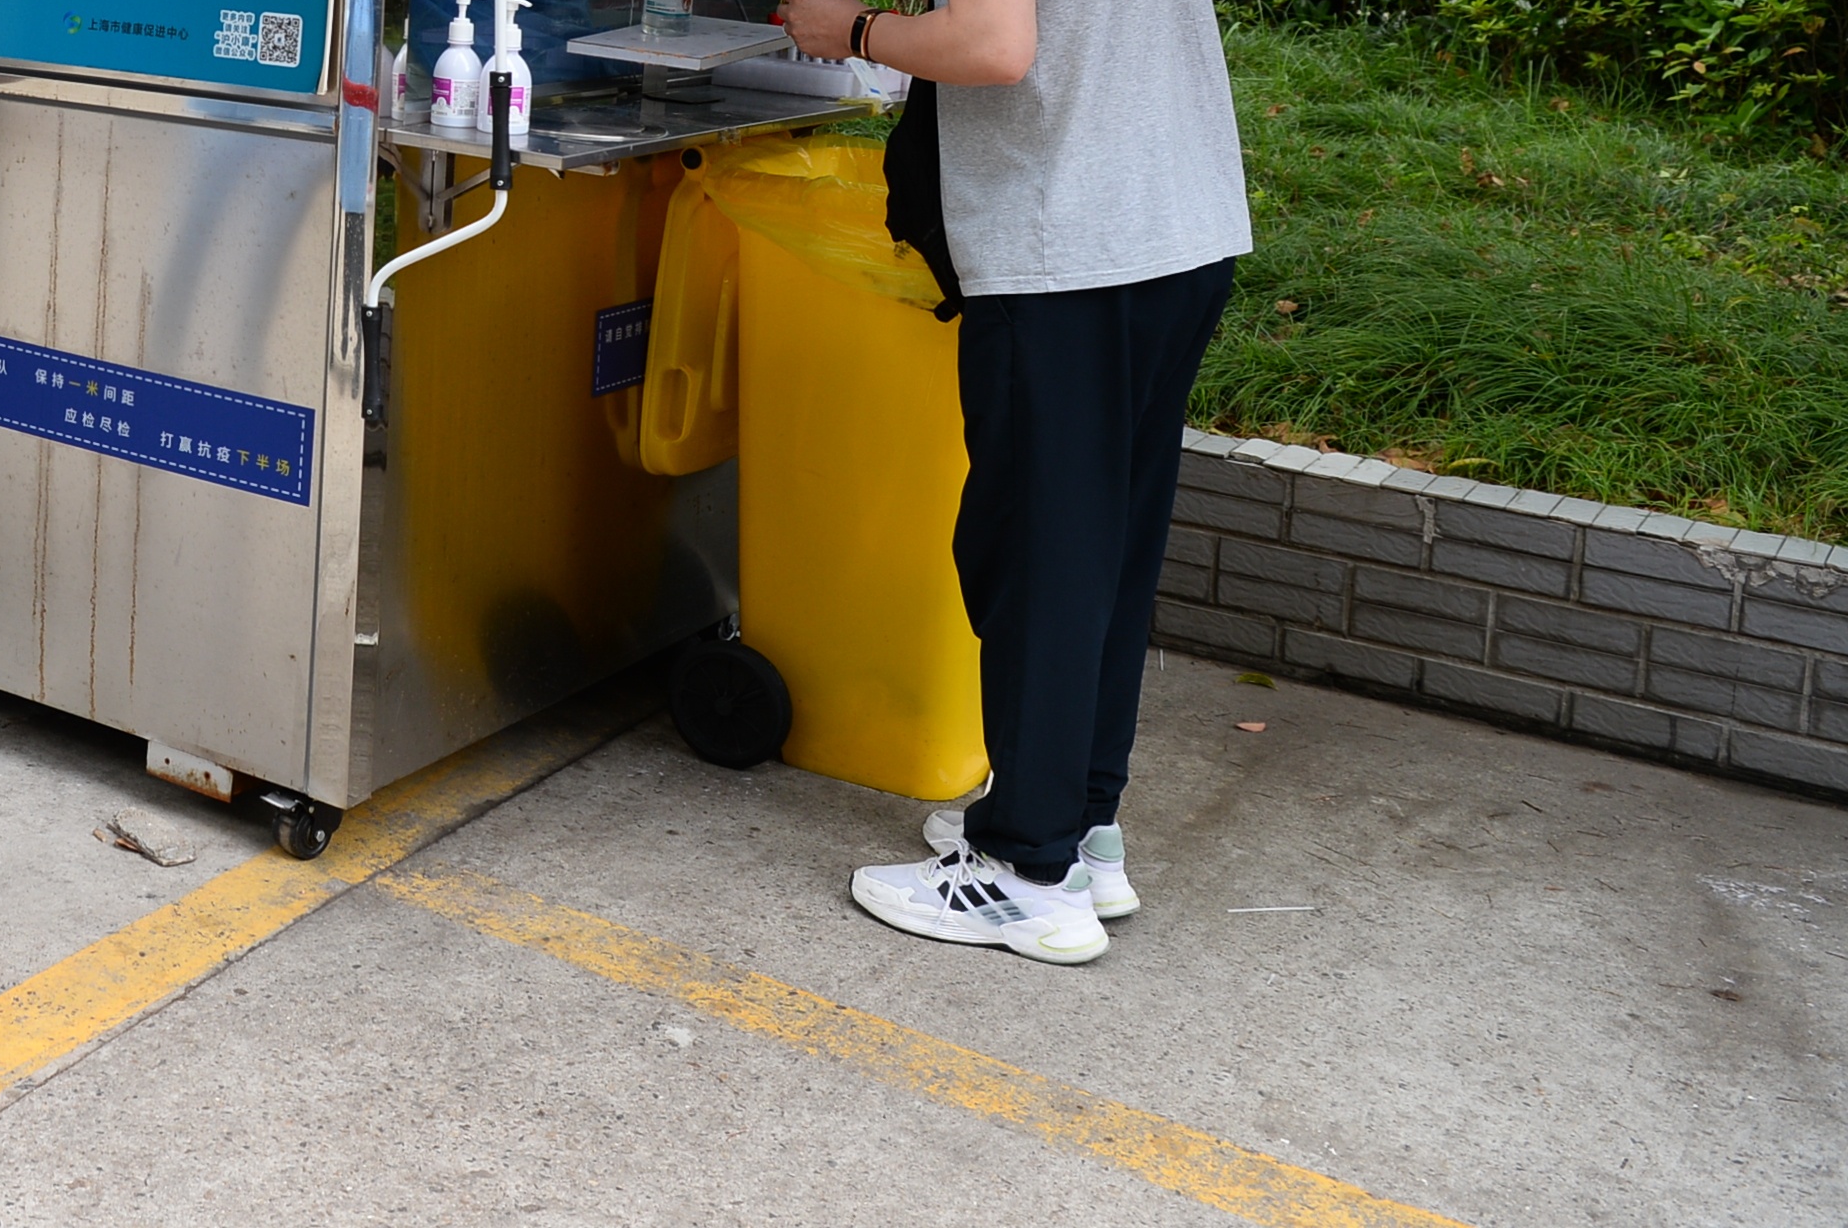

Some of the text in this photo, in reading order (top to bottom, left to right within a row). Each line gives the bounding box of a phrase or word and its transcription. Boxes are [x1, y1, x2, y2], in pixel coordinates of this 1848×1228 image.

[88, 17, 189, 41] 上海市健康促进中心
[34, 368, 136, 408] 保持一米间距
[64, 408, 292, 478] 应检尽检 打赢抗疫下半场
